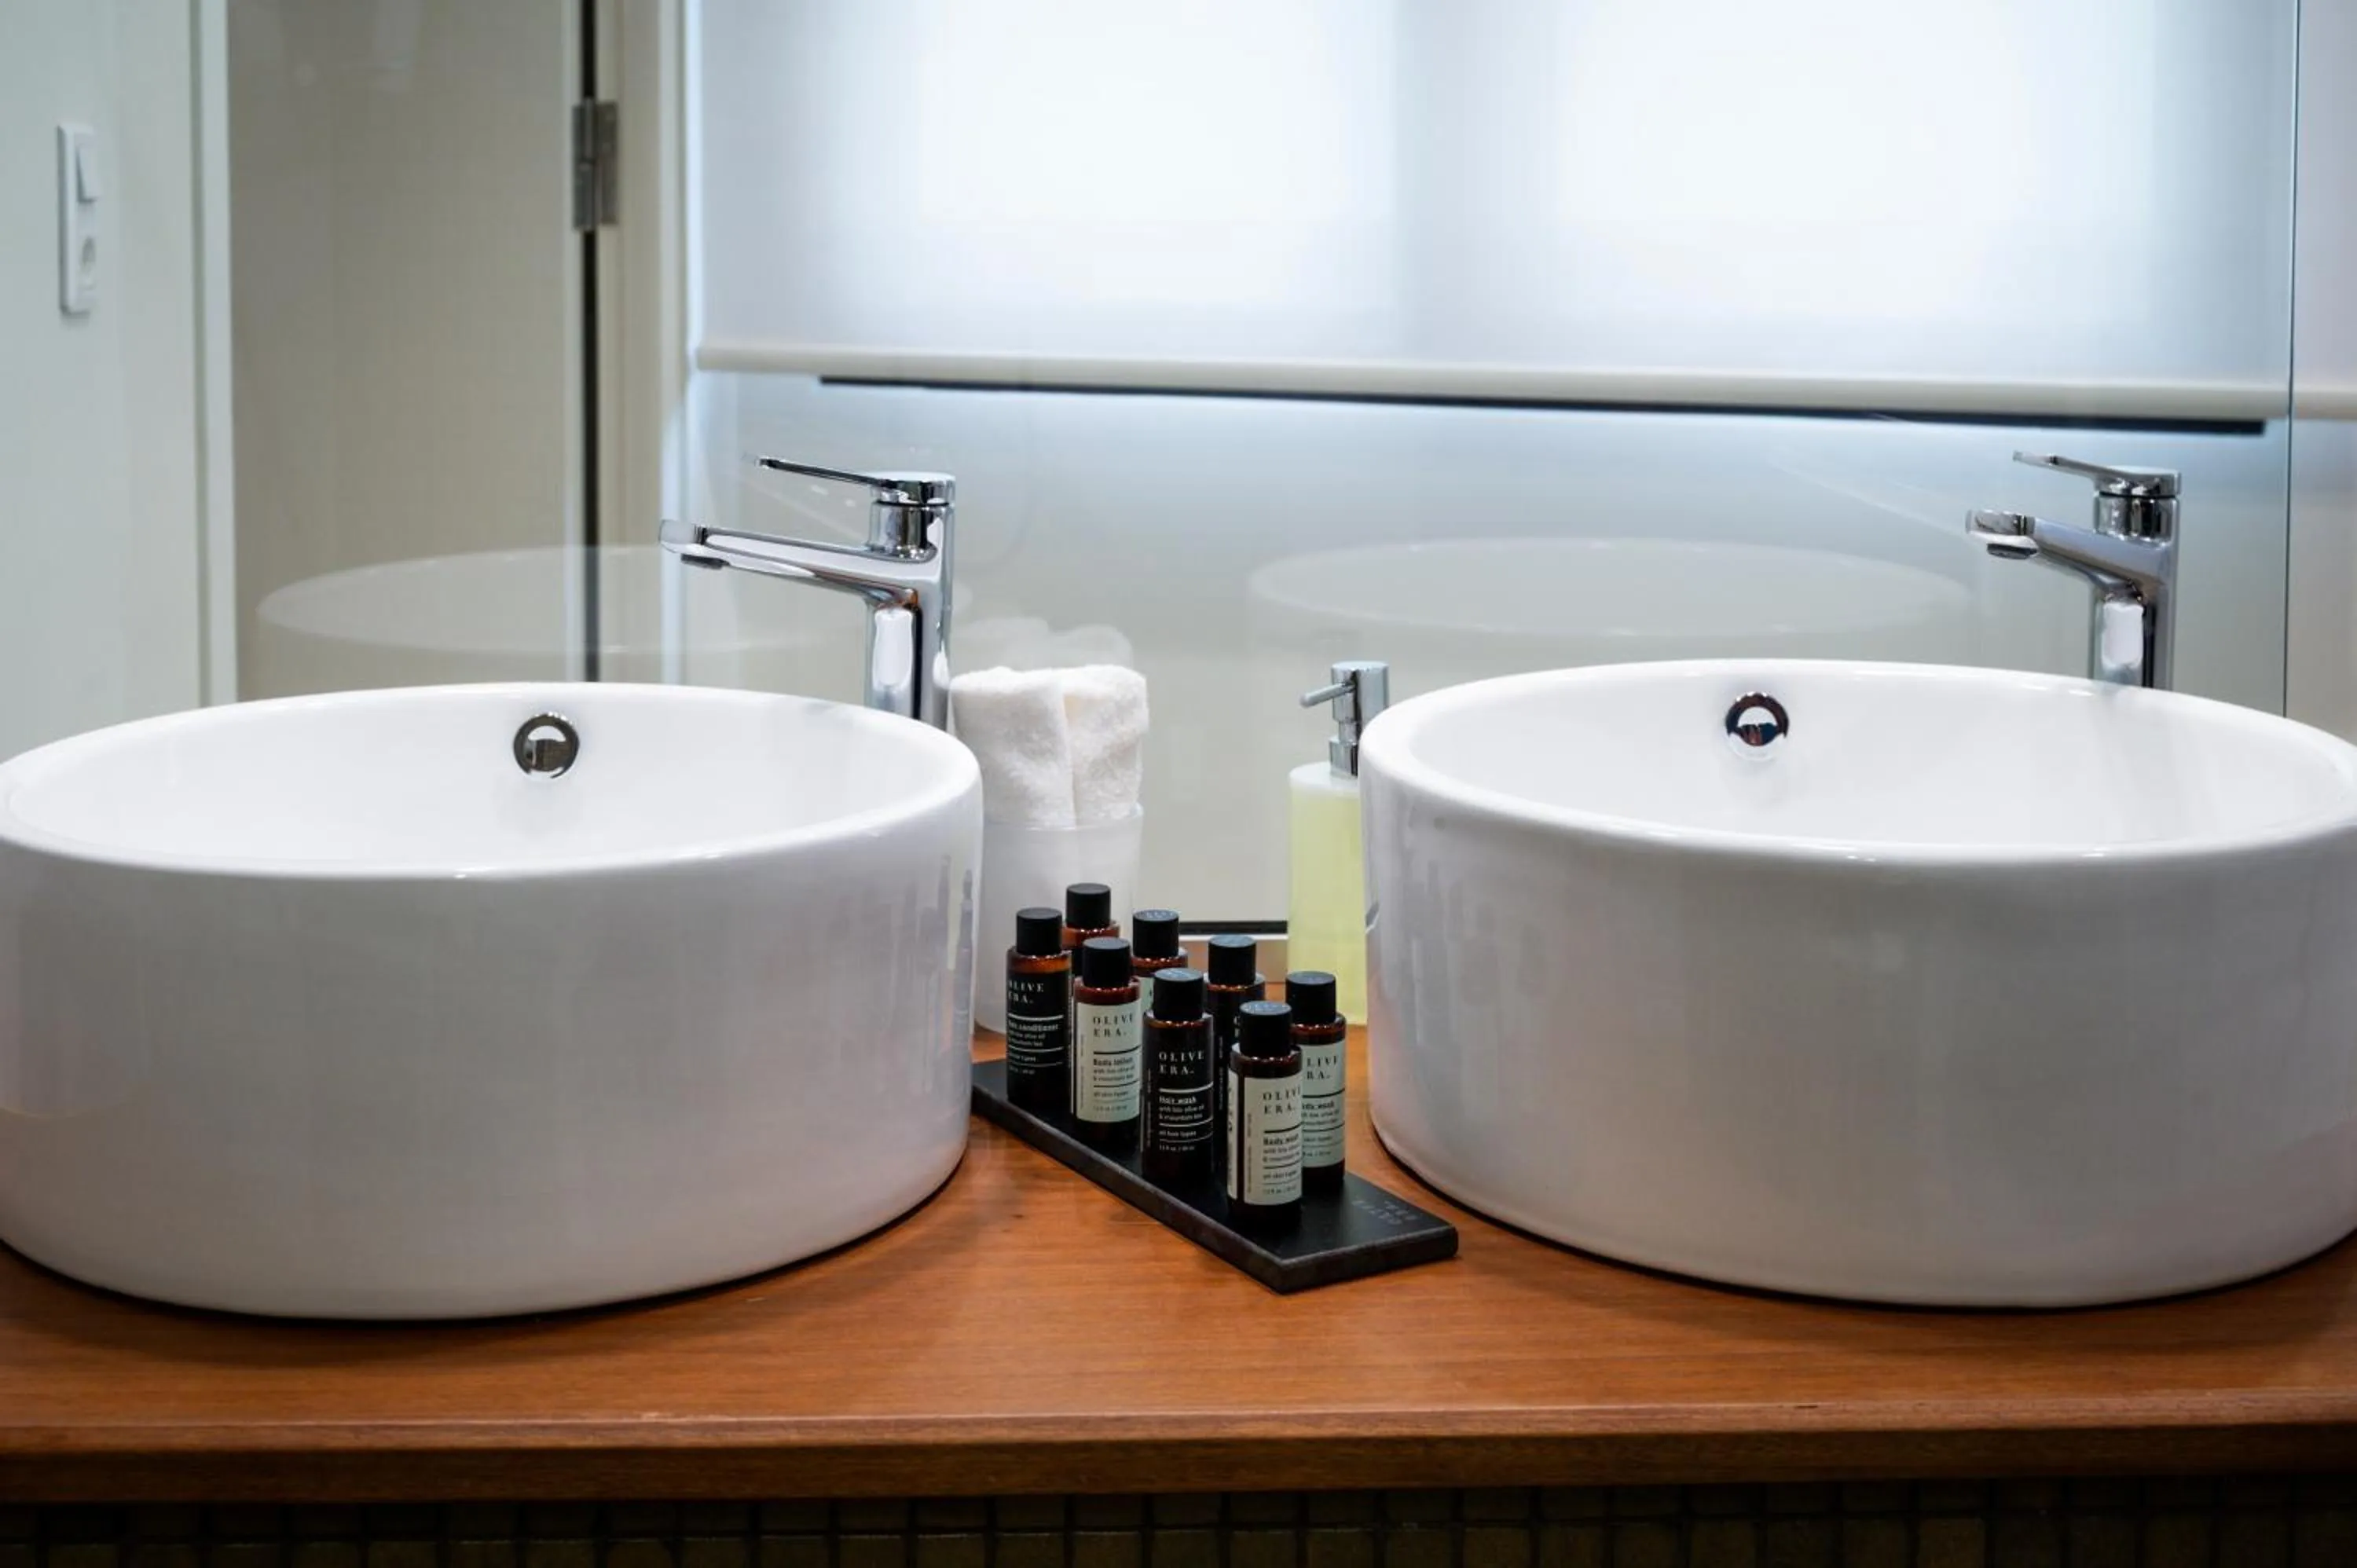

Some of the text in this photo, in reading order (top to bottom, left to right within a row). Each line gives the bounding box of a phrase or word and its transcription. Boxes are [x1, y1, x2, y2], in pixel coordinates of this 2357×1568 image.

[1093, 1028, 1127, 1037] ERA.
[1158, 1050, 1204, 1062] OLIVE
[1307, 1055, 1338, 1067] LIV
[1159, 1064, 1194, 1075] ERA.
[1307, 1071, 1332, 1080] RA.
